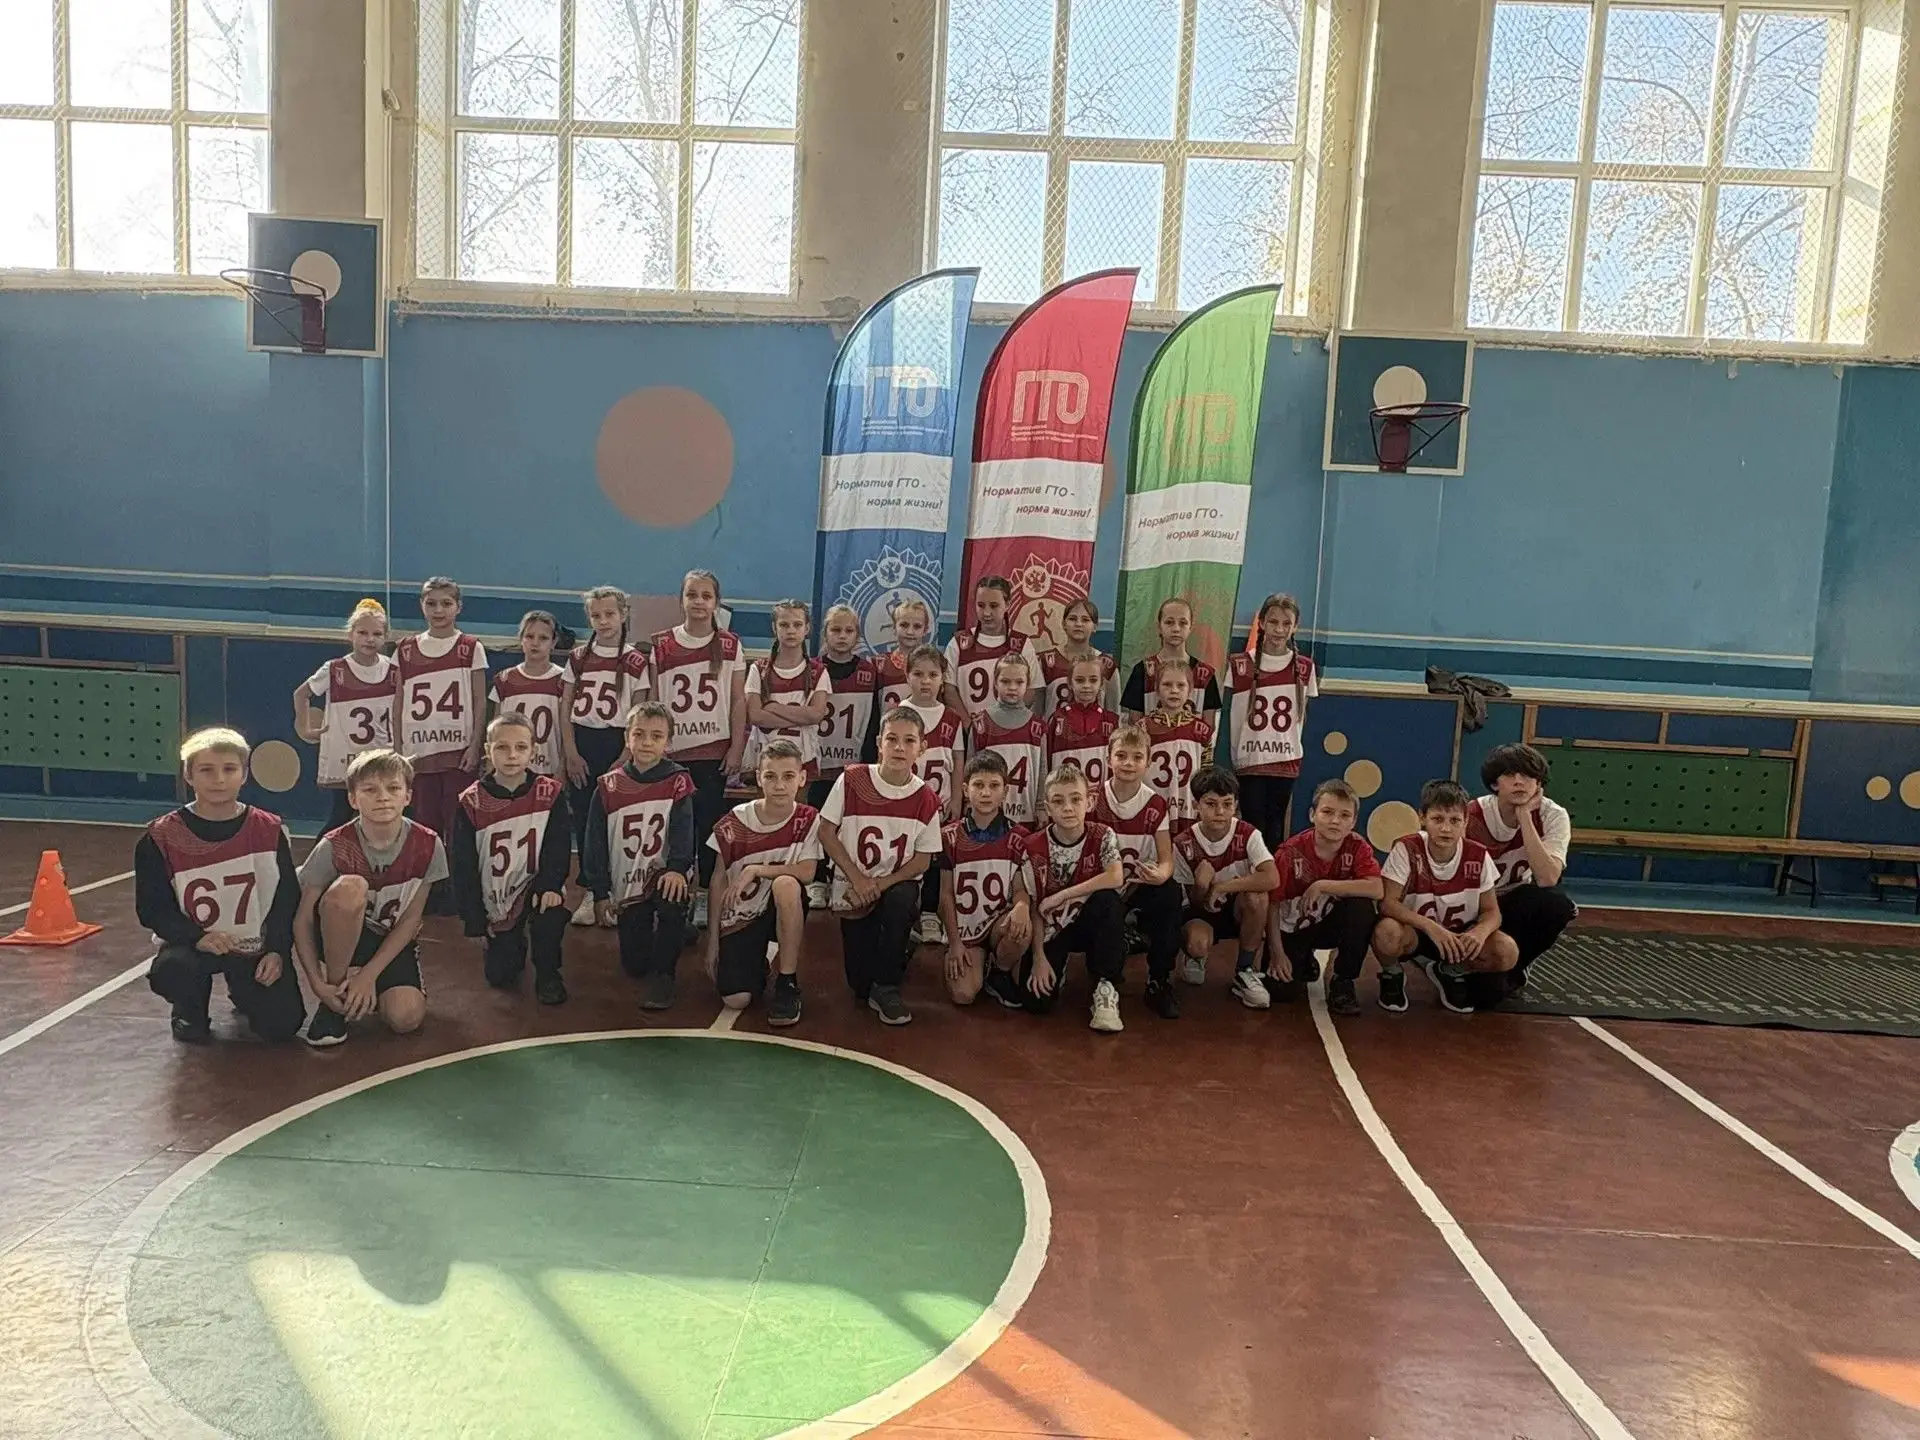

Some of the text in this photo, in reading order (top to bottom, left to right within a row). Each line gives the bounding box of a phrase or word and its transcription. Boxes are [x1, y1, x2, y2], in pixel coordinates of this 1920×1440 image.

[863, 366, 938, 418] ГТО
[1012, 370, 1090, 425] ГТО
[834, 476, 893, 492] Норматив
[896, 477, 920, 489] ГТО
[866, 497, 943, 510] норма жизни!
[982, 486, 1042, 500] Норматив
[1045, 485, 1068, 498] ГТО
[1016, 504, 1092, 519] норма жизни!
[1138, 511, 1192, 529] Норматив
[1194, 508, 1218, 519] ГТО
[1166, 529, 1240, 542] норма жизни!
[411, 681, 464, 721] 54
[574, 680, 618, 720] 55
[671, 673, 718, 713] 35
[969, 667, 989, 703] 9
[349, 706, 393, 745] 31
[515, 702, 553, 746] 0
[1248, 695, 1293, 733] 88
[1151, 750, 1193, 788] 39
[490, 828, 537, 877] 51
[623, 813, 665, 859] 53
[858, 826, 909, 874] 61
[184, 872, 256, 929] 67
[956, 872, 1007, 915] 59
